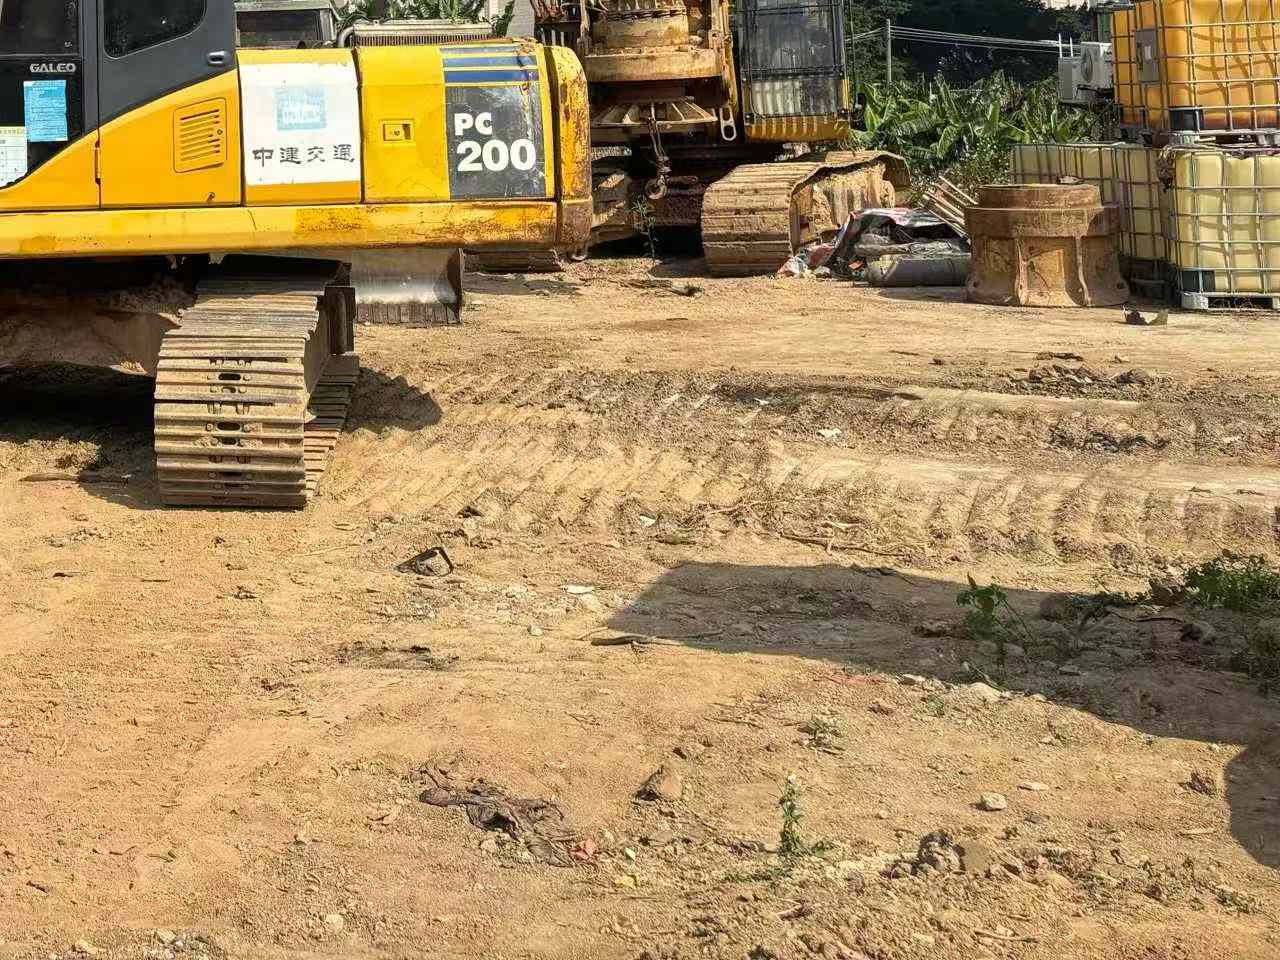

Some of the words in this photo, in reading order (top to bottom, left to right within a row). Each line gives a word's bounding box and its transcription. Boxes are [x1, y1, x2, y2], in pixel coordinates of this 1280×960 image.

[29, 63, 76, 73] GALEO
[454, 112, 492, 136] PC
[252, 143, 355, 167] 中建交通
[457, 139, 537, 172] 200
